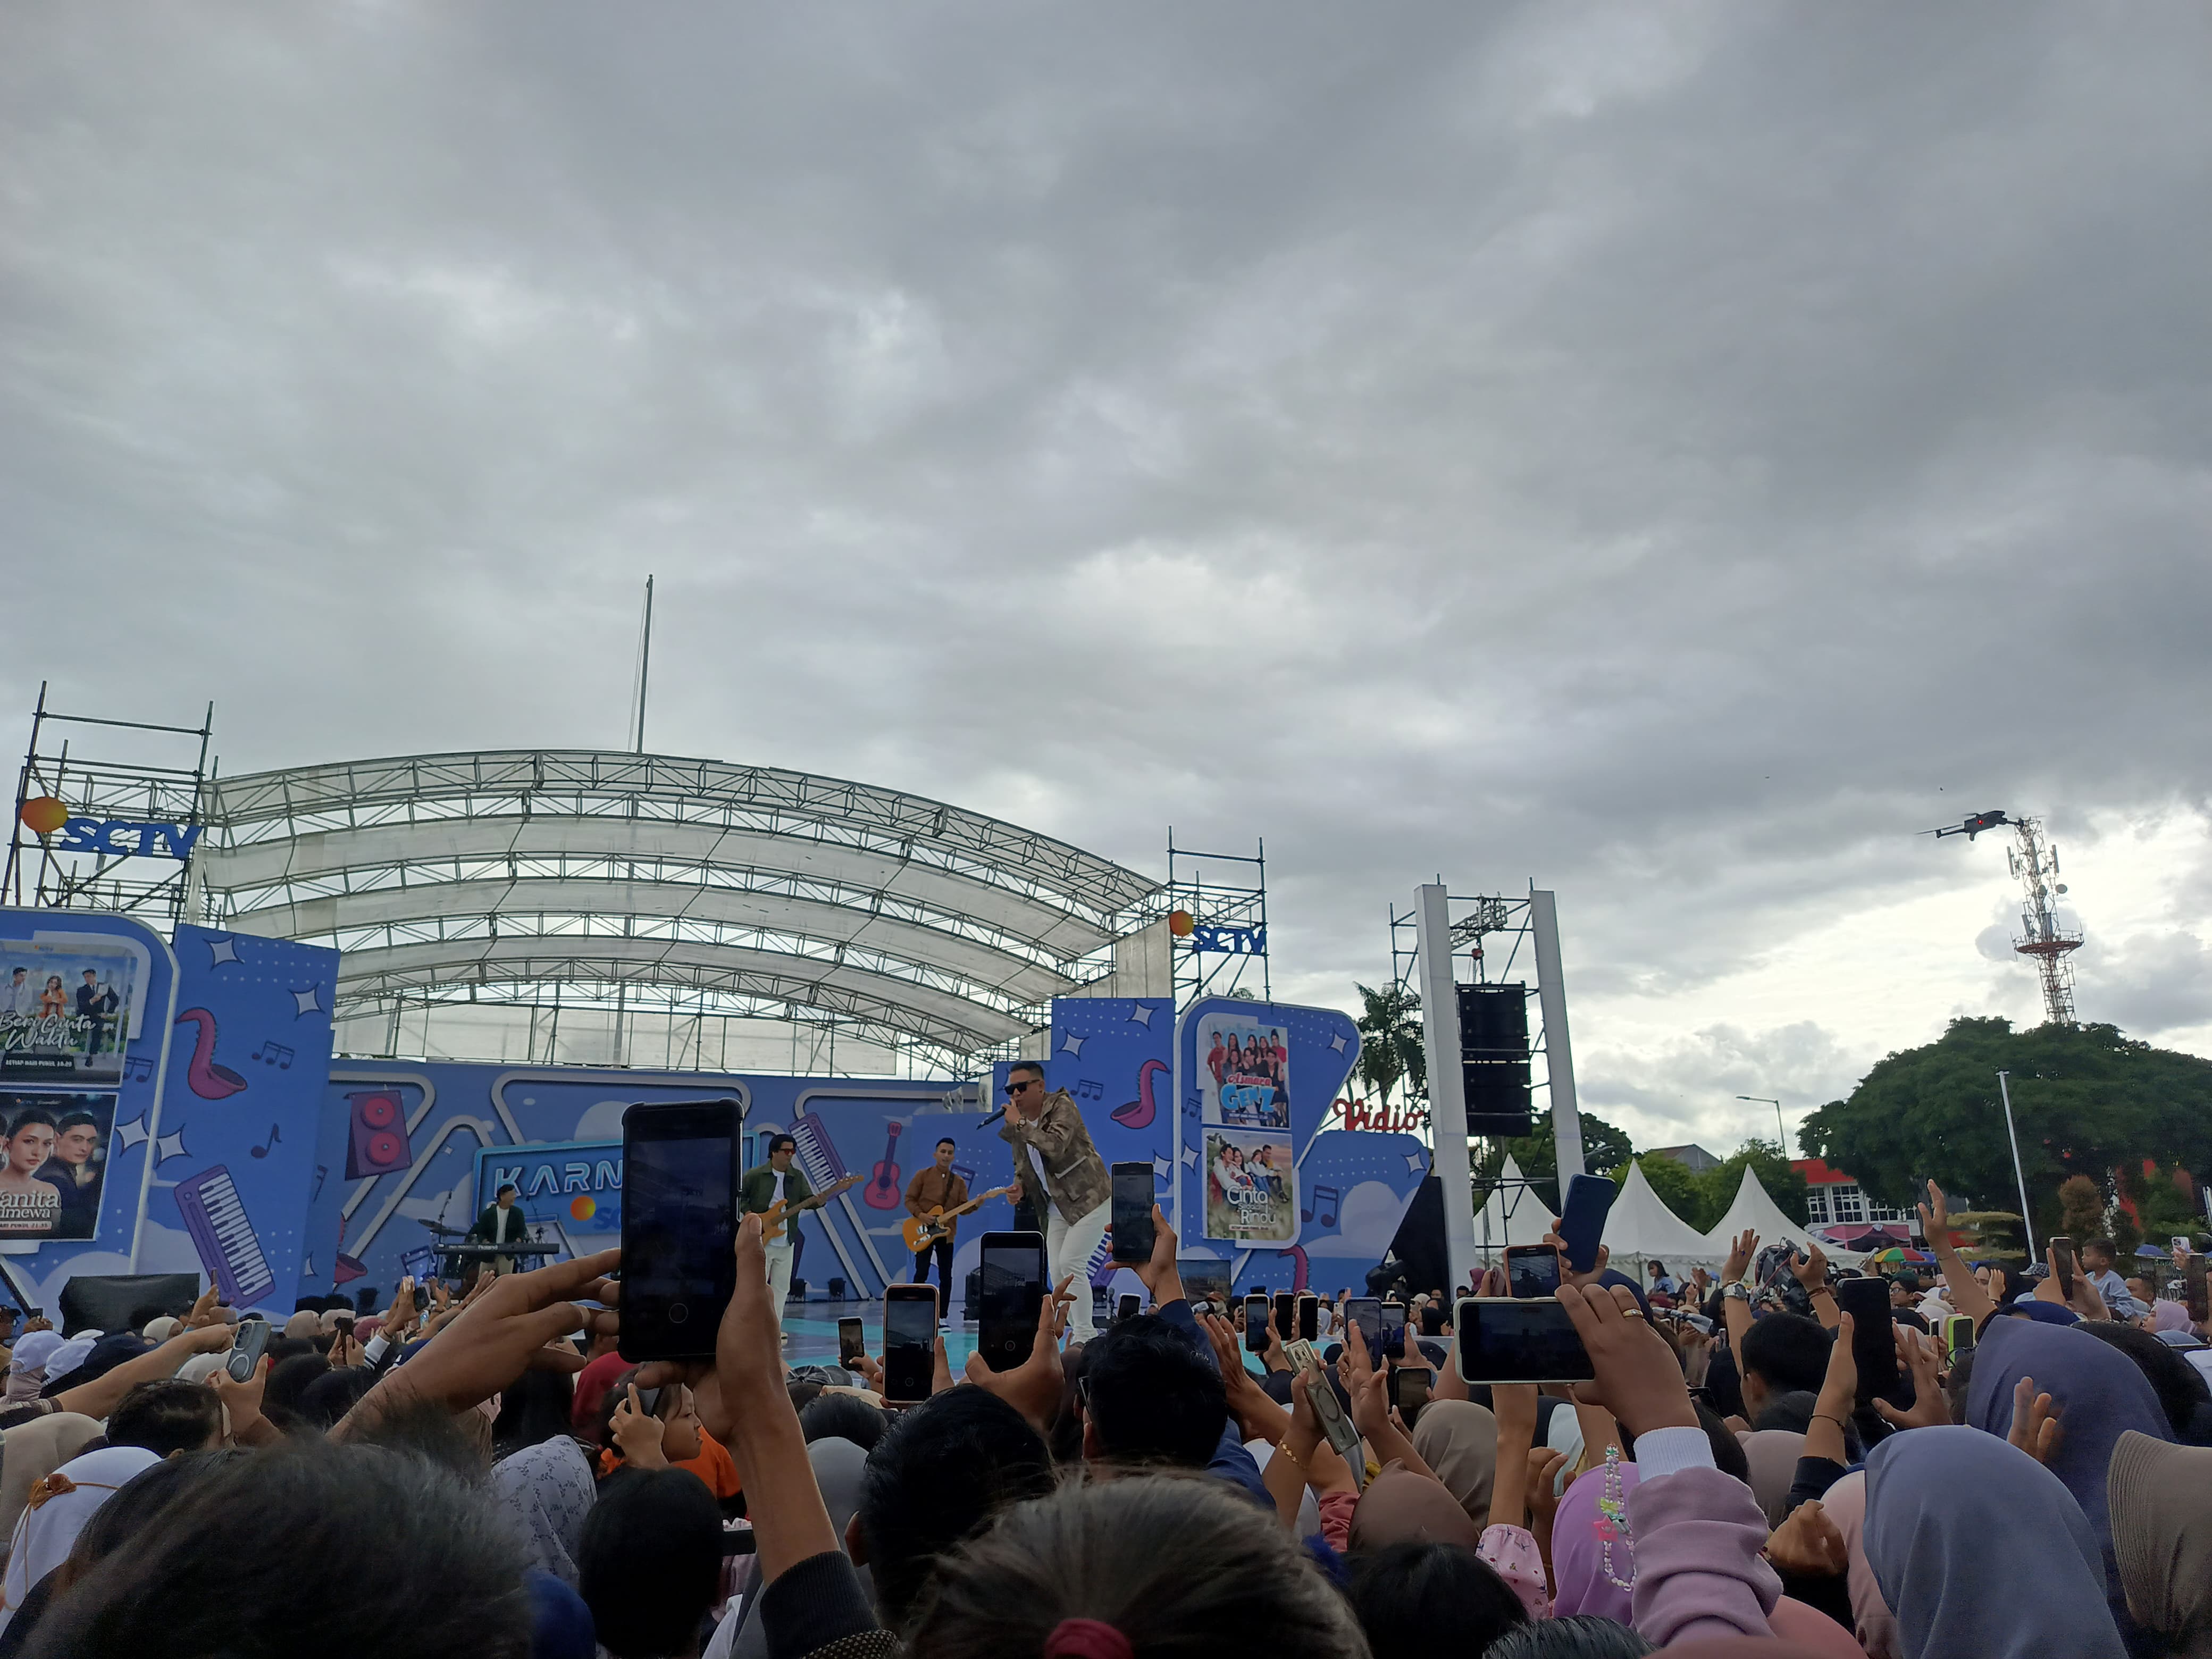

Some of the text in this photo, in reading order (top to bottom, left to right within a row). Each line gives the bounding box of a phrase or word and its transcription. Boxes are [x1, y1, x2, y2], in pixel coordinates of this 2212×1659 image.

[60, 817, 203, 859] SCTV
[1193, 925, 1266, 956] SCTV
[41, 1013, 96, 1033] Cinta
[4, 1029, 78, 1050] Waktu
[1227, 1072, 1272, 1086] Asmara
[1221, 1084, 1276, 1112] GEN Z
[1333, 1098, 1424, 1131] Vidio
[494, 1159, 623, 1197] KARN
[0, 1191, 60, 1208] anita
[1227, 1185, 1268, 1204] Cinta
[1241, 1204, 1276, 1224] Rindu
